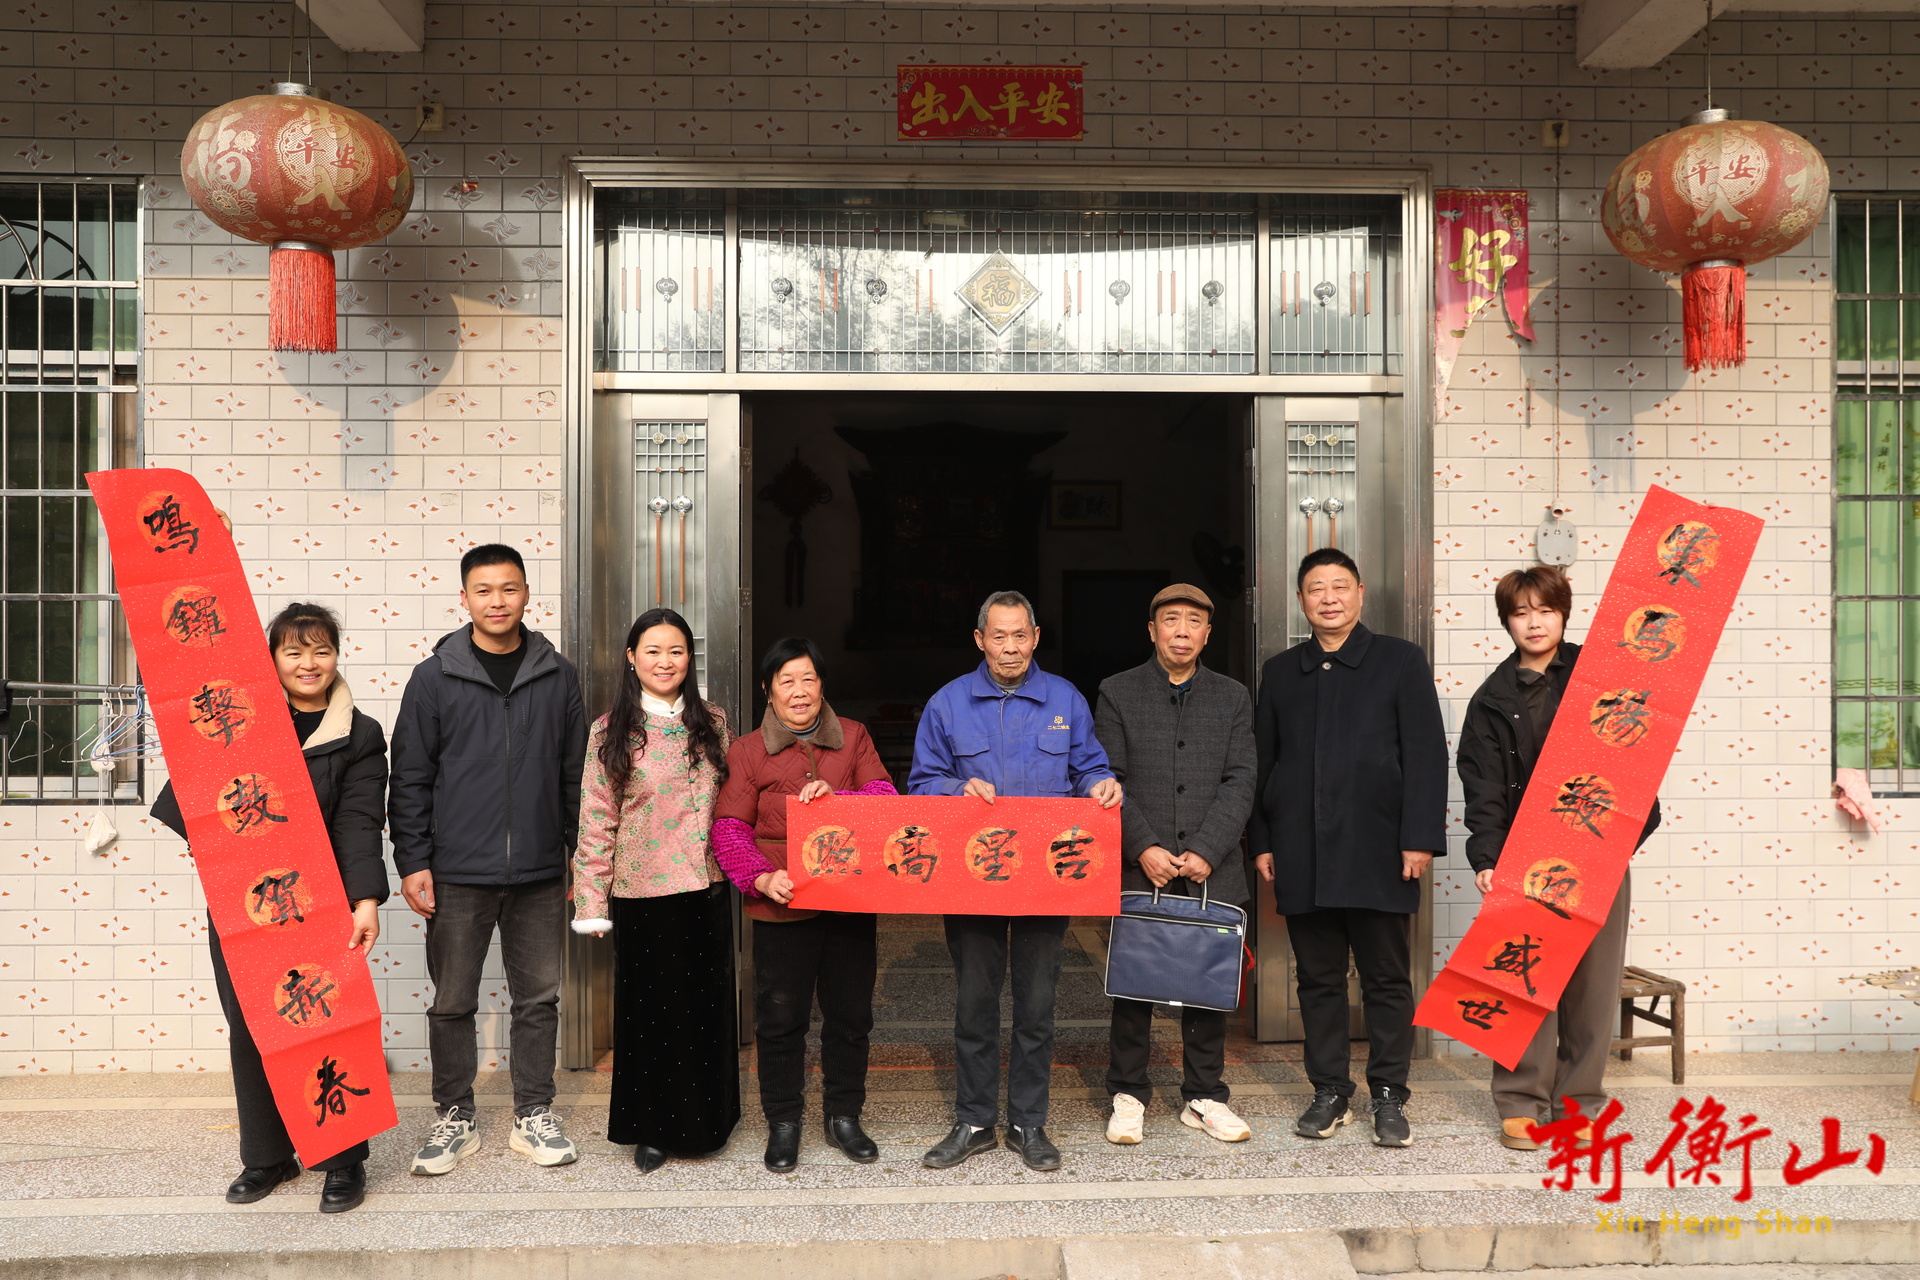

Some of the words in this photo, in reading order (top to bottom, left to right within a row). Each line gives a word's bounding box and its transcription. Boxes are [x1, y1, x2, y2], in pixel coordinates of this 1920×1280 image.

[911, 81, 1071, 126] 出入平安
[287, 136, 361, 170] 平安
[1683, 154, 1757, 186] 平安
[1448, 226, 1518, 293] 好
[981, 273, 1016, 308] 福
